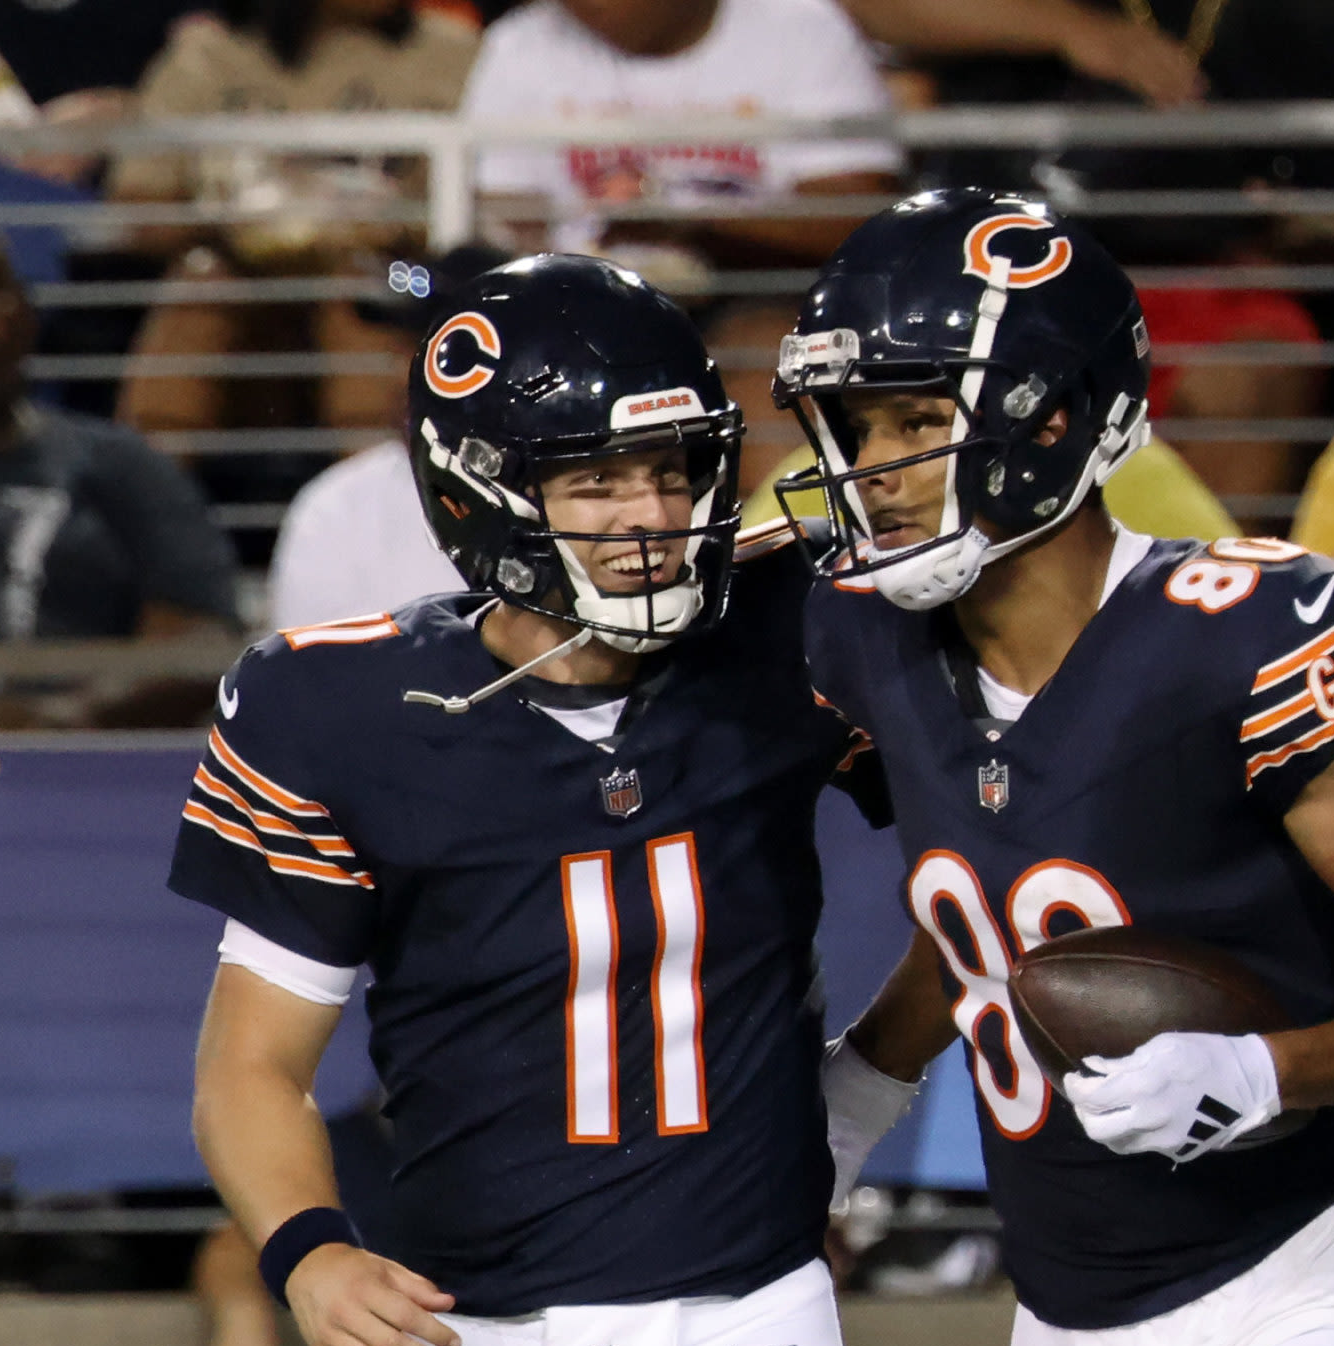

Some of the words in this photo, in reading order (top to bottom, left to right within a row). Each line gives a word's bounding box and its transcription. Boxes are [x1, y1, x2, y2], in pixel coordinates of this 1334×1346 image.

[628, 394, 691, 415] BEARS
[1164, 537, 1310, 615] 80
[560, 831, 709, 1144] 11
